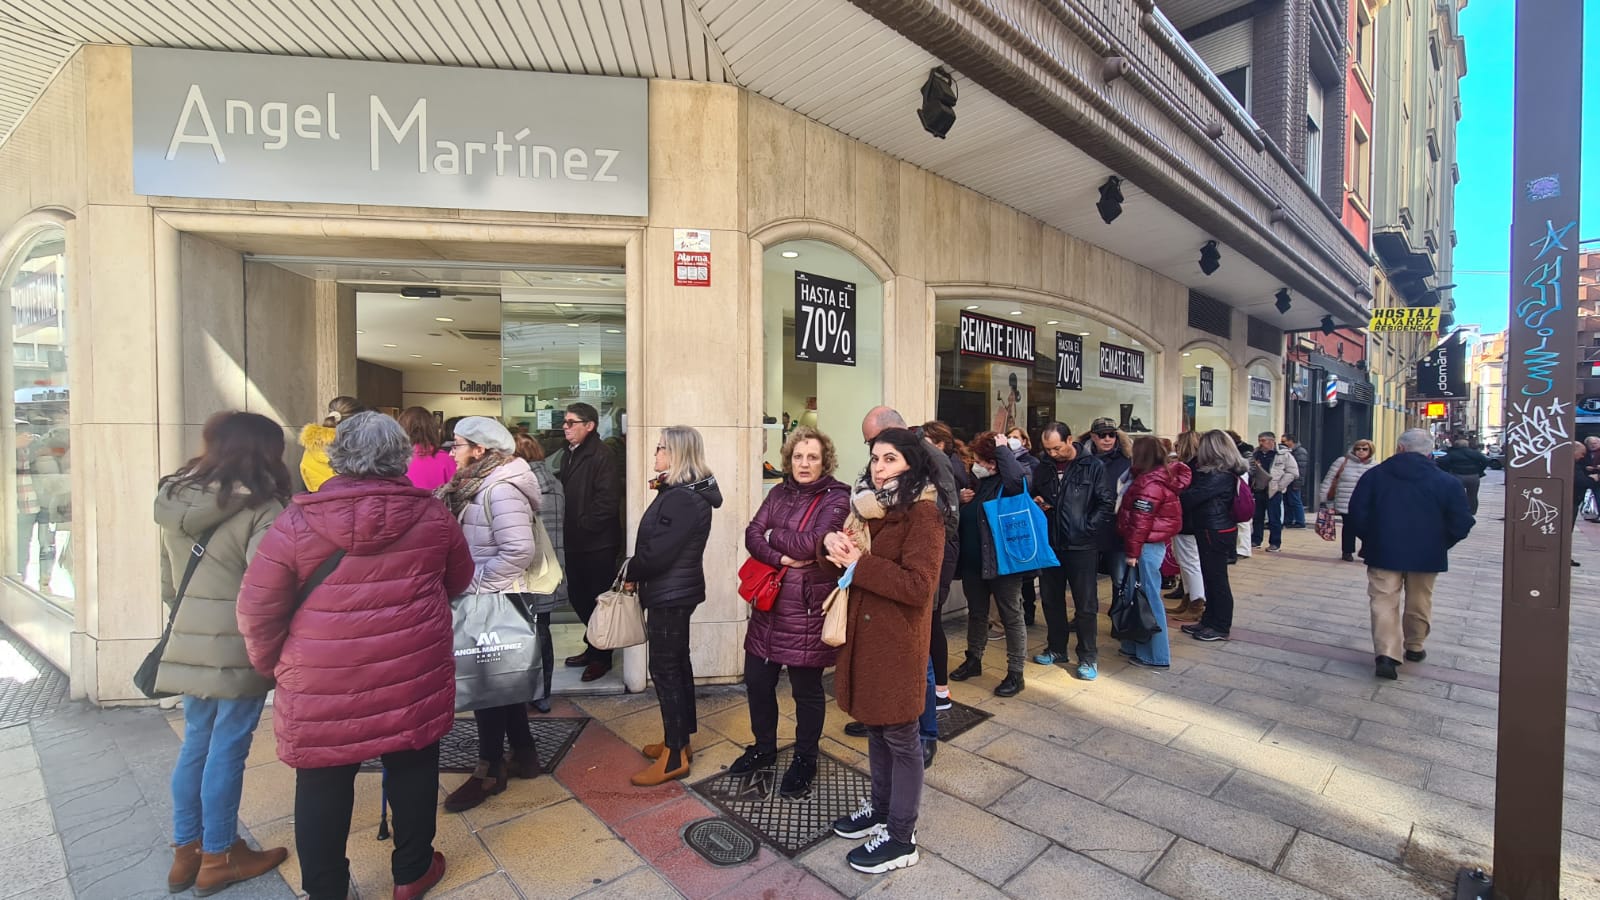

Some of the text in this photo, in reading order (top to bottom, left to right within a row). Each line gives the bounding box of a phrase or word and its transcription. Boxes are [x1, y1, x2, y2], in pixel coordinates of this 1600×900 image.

[166, 84, 622, 183] Angel Martínez
[677, 253, 708, 262] Alarma
[801, 283, 851, 309] HASTA EL
[1374, 309, 1437, 318] HOSTAL
[1374, 317, 1435, 326] ALVAREZ
[801, 305, 851, 355] 70%
[961, 316, 1035, 361] REMATE FINAL
[1058, 339, 1073, 352] HASTA
[1058, 353, 1081, 384] 70%
[1100, 347, 1144, 379] REMATE FINAL
[454, 642, 522, 657] ANGEL MARTINEZ
